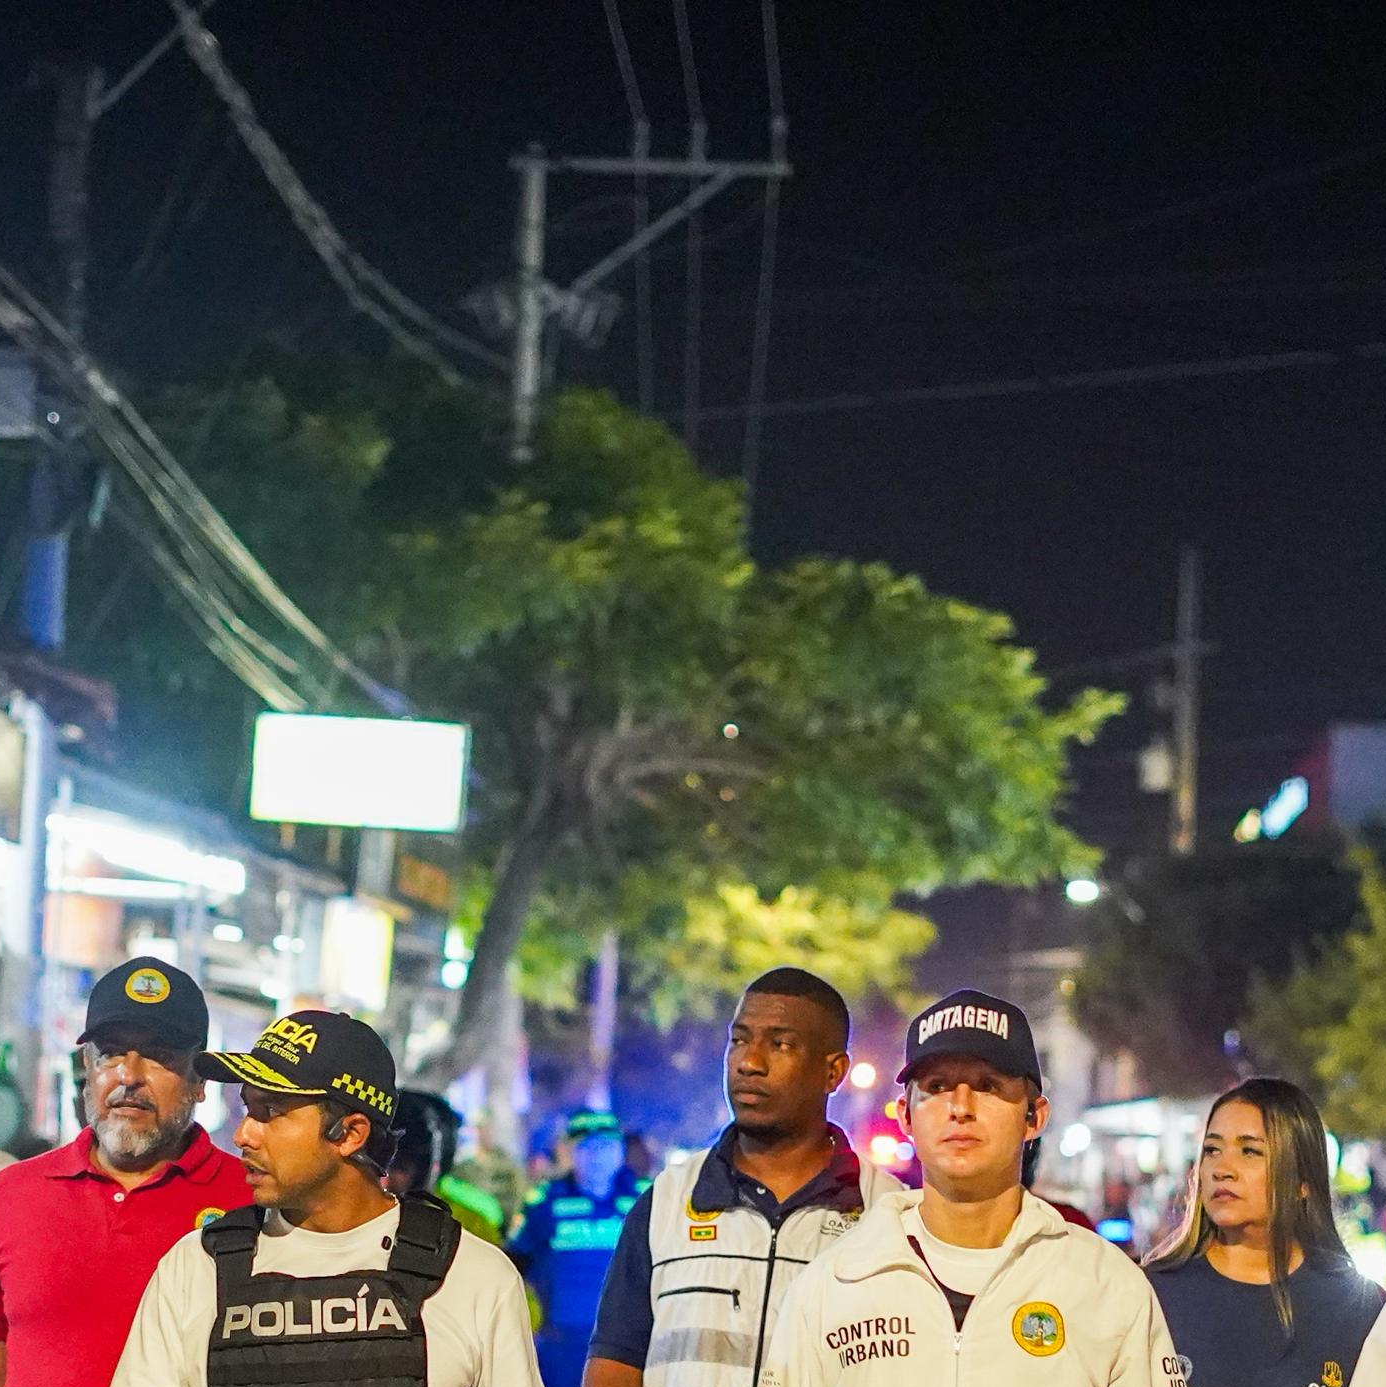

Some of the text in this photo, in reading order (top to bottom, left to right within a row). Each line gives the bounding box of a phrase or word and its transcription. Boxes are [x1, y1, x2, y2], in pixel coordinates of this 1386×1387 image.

[918, 1005, 1009, 1045] CARTAGENA
[221, 1283, 408, 1340] POLICÍA
[825, 1316, 916, 1350] CONTROL
